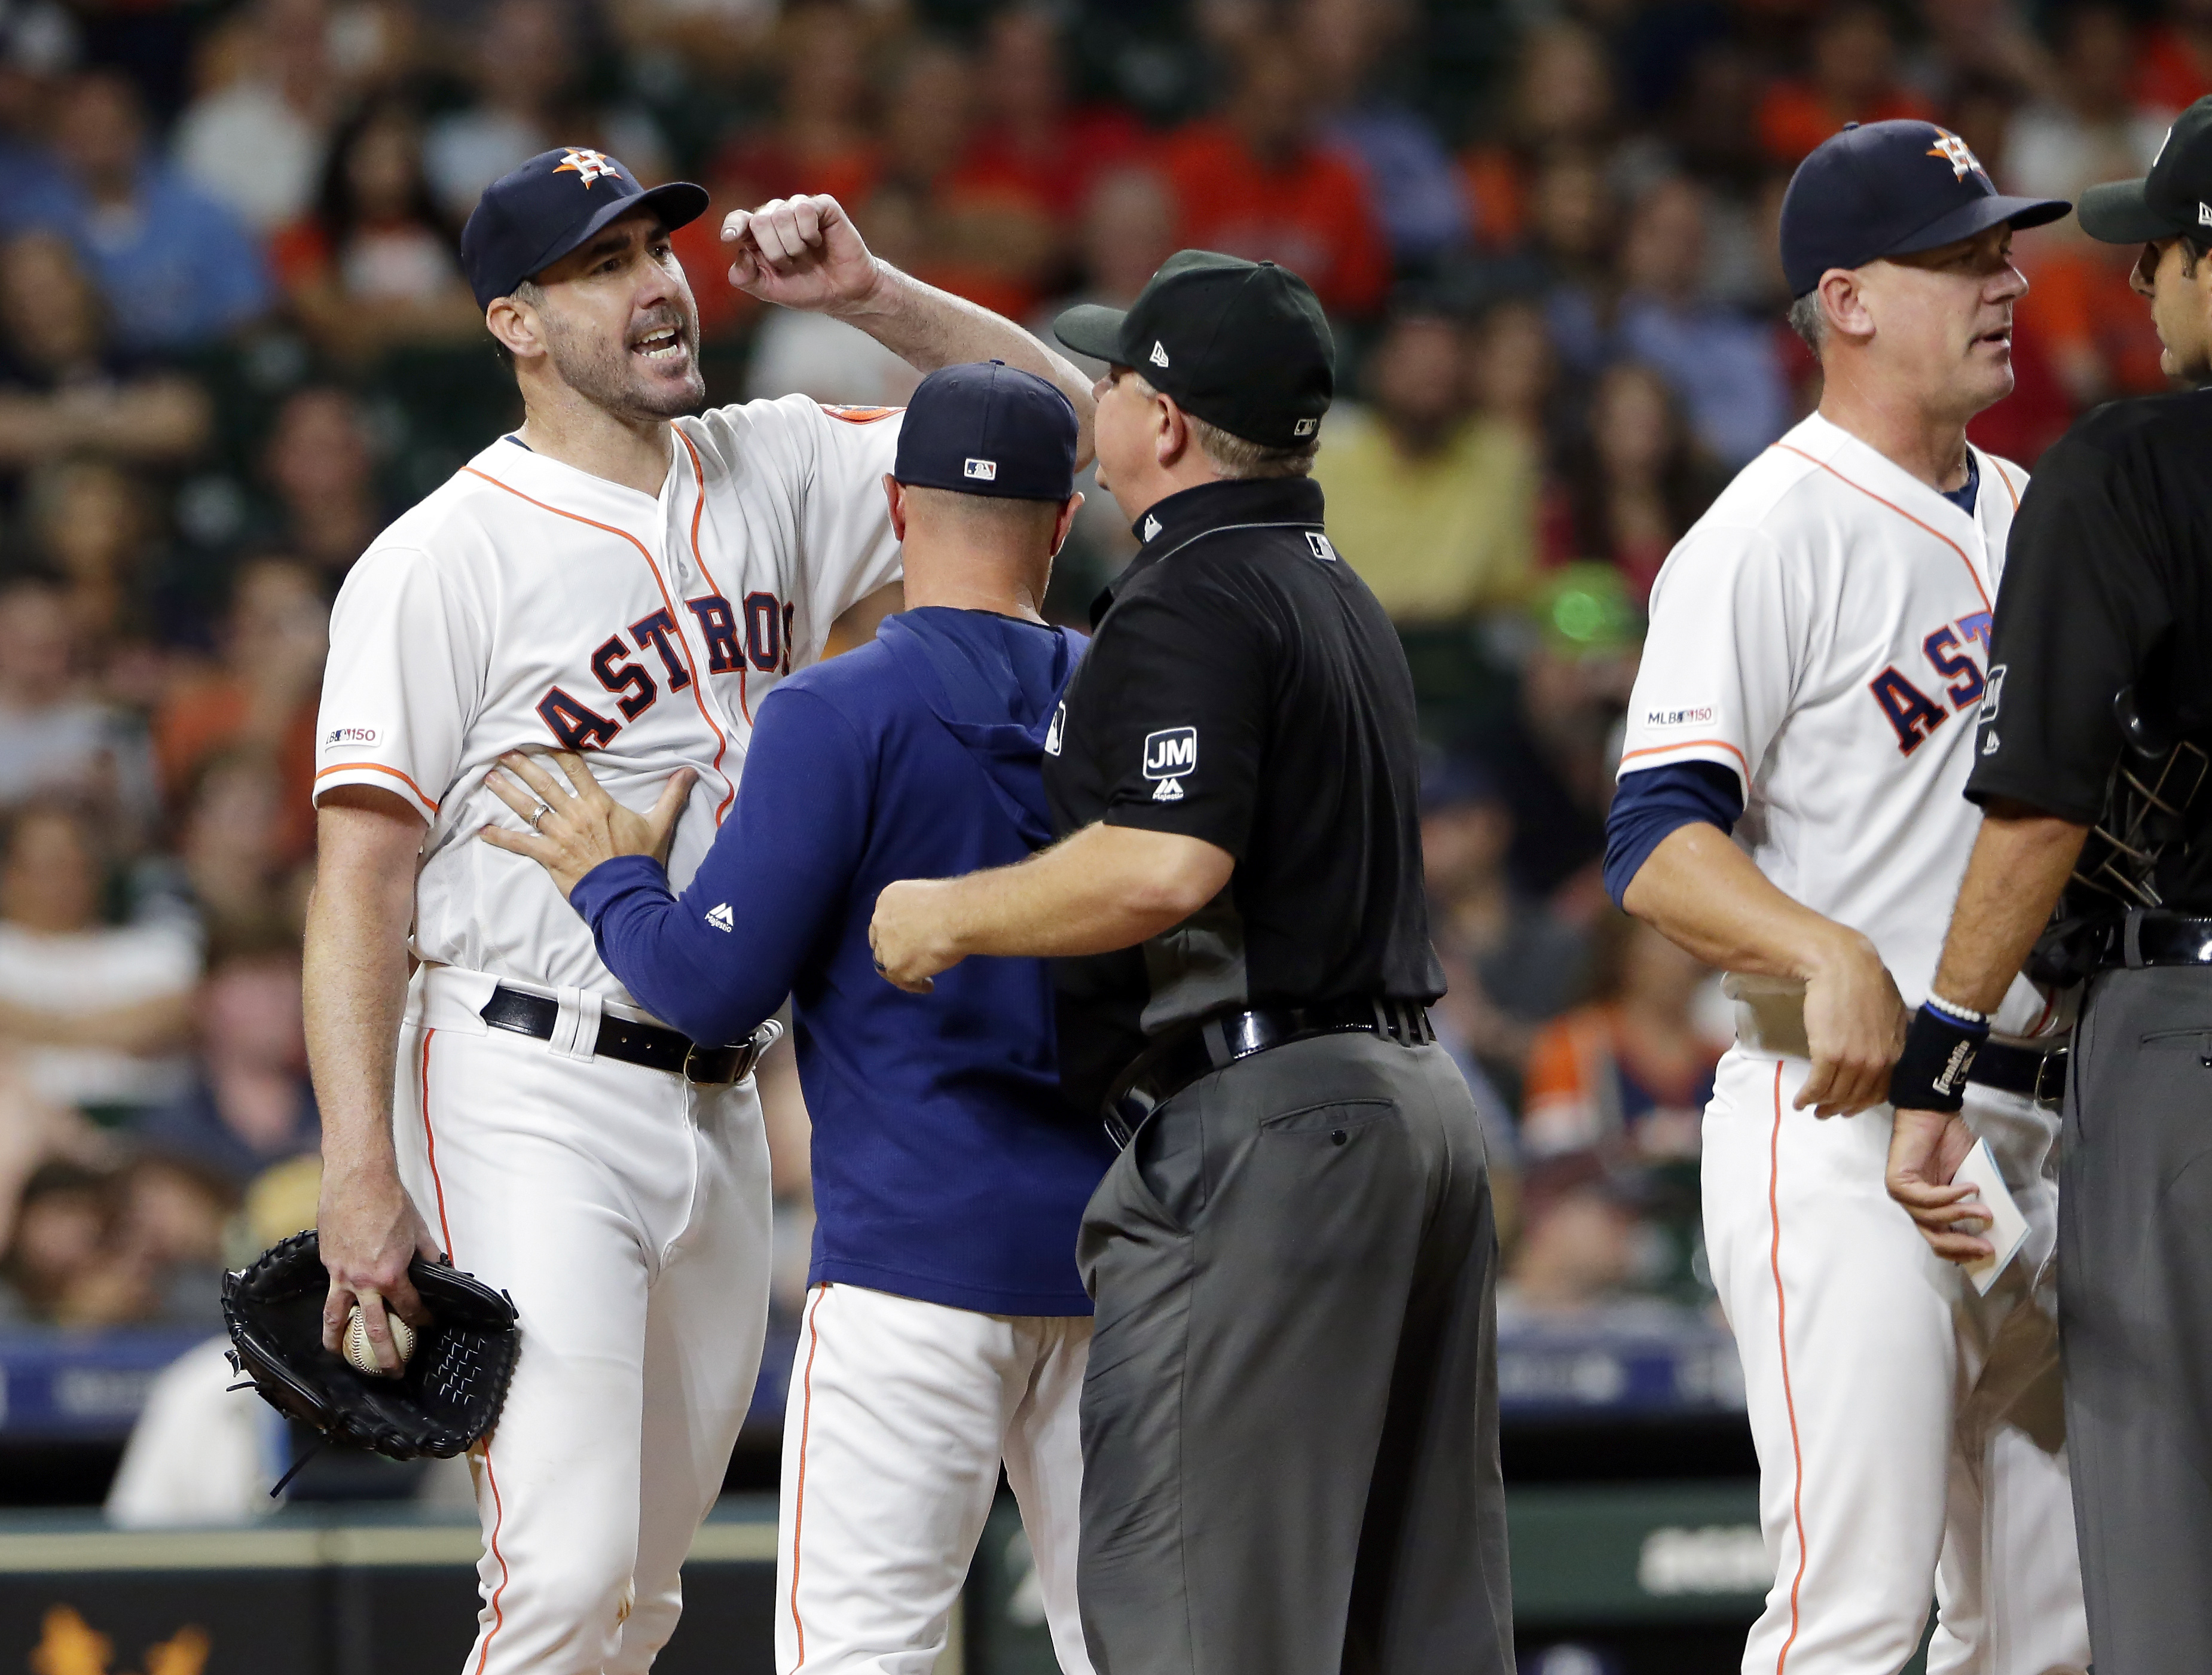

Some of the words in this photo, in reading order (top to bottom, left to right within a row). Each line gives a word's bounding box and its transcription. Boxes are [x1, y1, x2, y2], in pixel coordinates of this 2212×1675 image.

[560, 150, 616, 182] H
[1933, 138, 1980, 175] H
[1648, 712, 1676, 724] MLB
[1694, 707, 1712, 721] 150
[352, 728, 375, 740] 150
[1148, 737, 1193, 768] JM
[704, 913, 732, 932] Majestic
